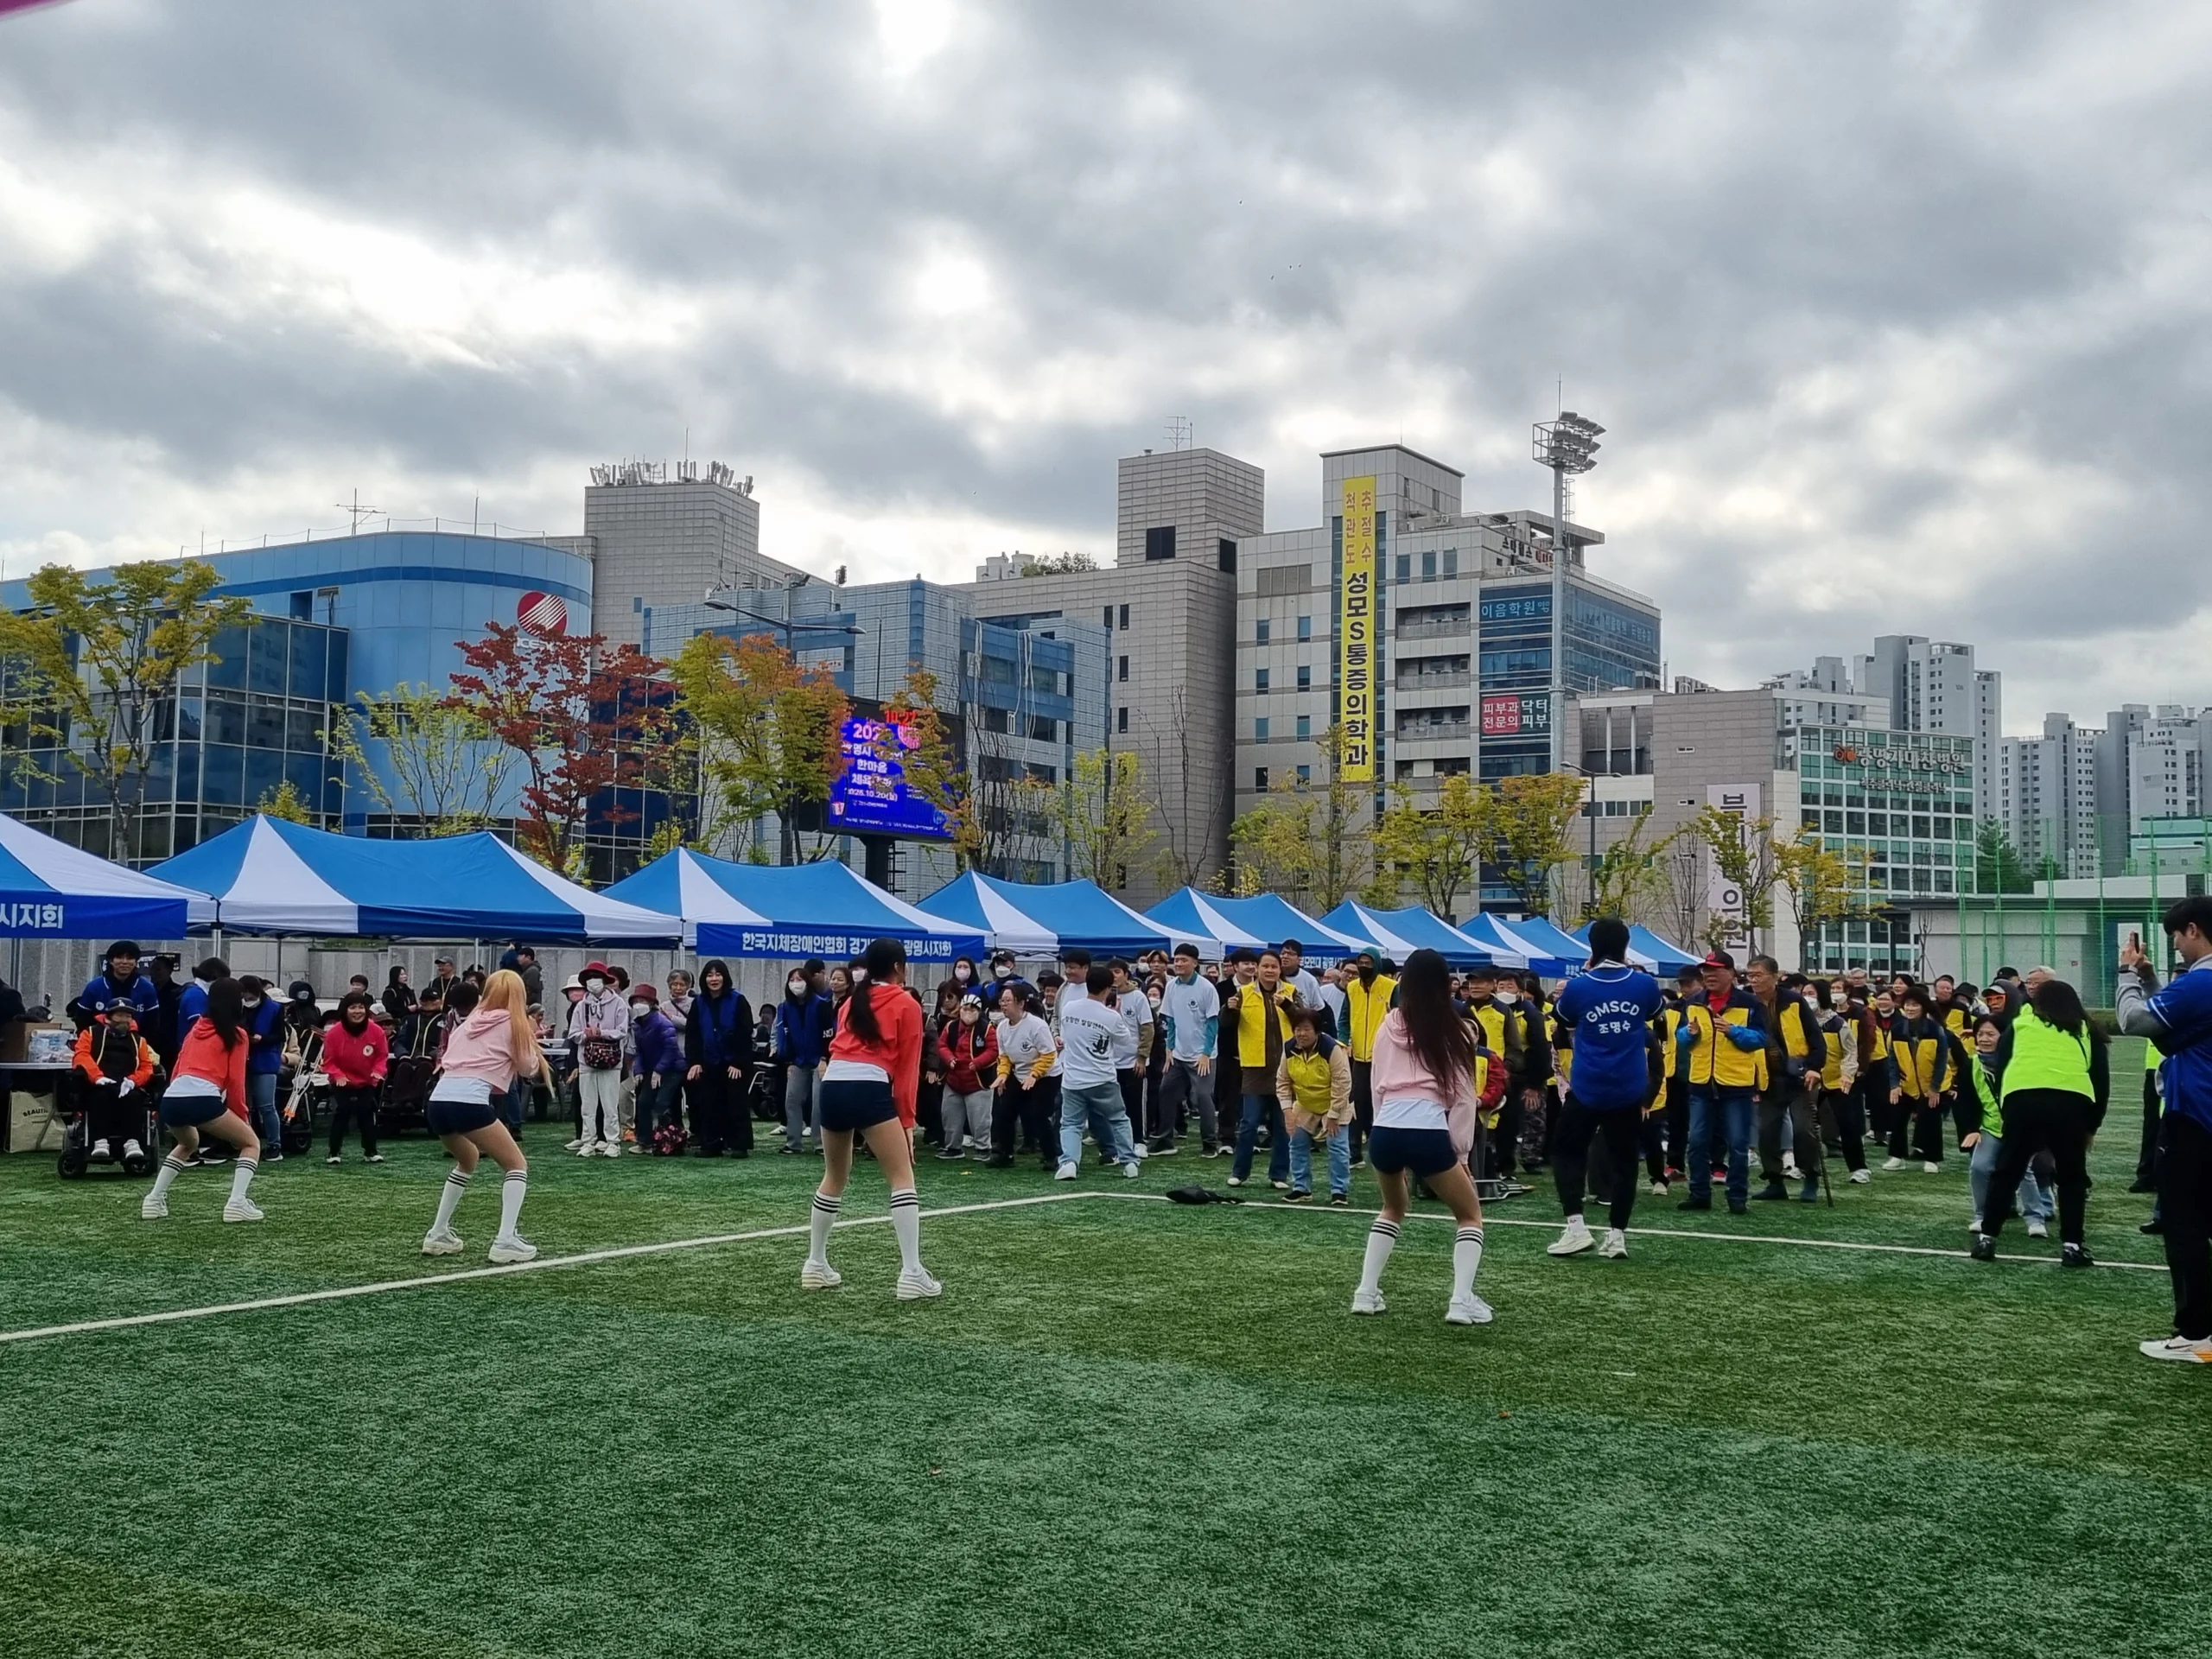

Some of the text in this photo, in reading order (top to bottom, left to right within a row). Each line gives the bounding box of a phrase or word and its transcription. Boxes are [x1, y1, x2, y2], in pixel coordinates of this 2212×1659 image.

[1481, 600, 1535, 619] 이음학원
[1345, 571, 1370, 766] 성모S통증의학과
[1483, 702, 1519, 715] 피부과
[1521, 699, 1551, 714] 닥터
[1483, 715, 1518, 729] 전문의
[1521, 714, 1551, 728] 피부
[853, 723, 892, 741] 202
[741, 931, 847, 955] 한국지체장애인협회
[1586, 1001, 1640, 1023] GMSCD
[1598, 1020, 1631, 1034] 조명수
